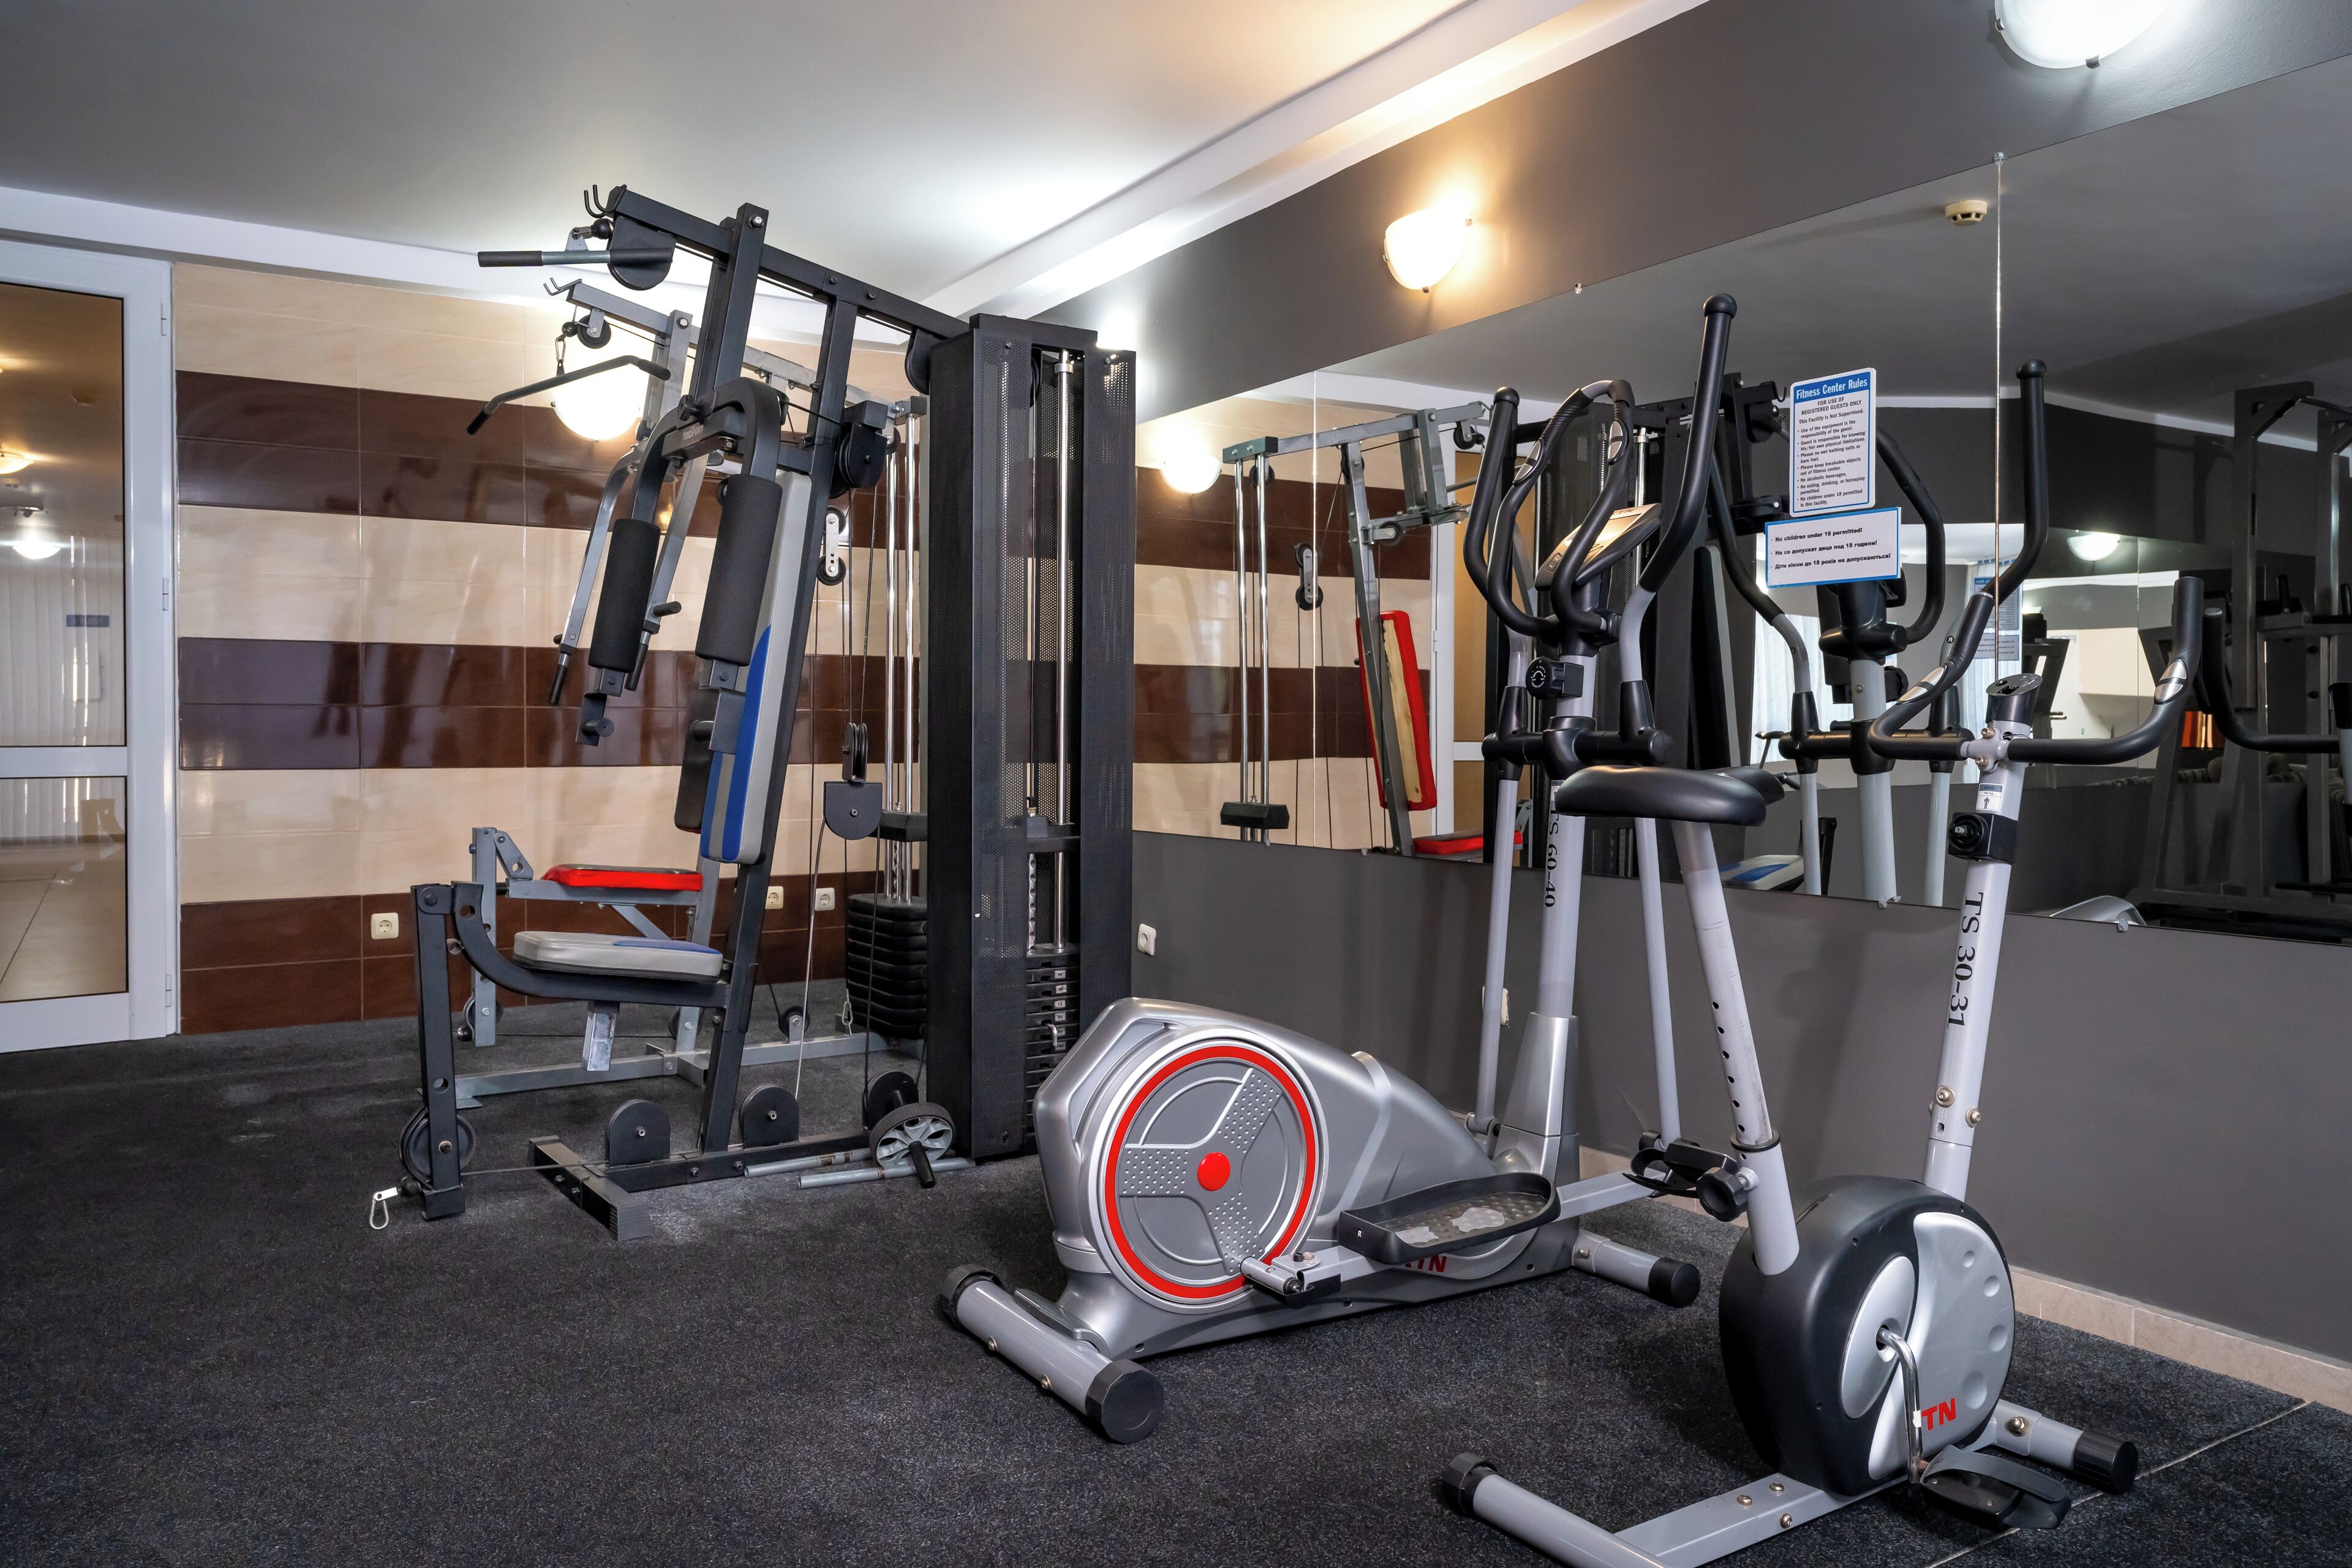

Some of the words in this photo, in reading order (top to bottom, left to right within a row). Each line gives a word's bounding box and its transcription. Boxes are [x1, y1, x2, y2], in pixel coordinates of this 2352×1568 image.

[1796, 388, 1820, 399] Fitness
[1823, 383, 1846, 394] Center
[1849, 378, 1868, 390] Rules
[1801, 406, 1829, 415] REGISTERED
[1838, 409, 1864, 417] Supervised.
[1833, 527, 1863, 537] permitted!
[1846, 553, 1891, 563] допускаються!
[1545, 843, 1558, 908] 60-40
[1961, 892, 1984, 933] TS
[1947, 945, 1976, 1030] 30-31
[1916, 1398, 1956, 1432] TN
